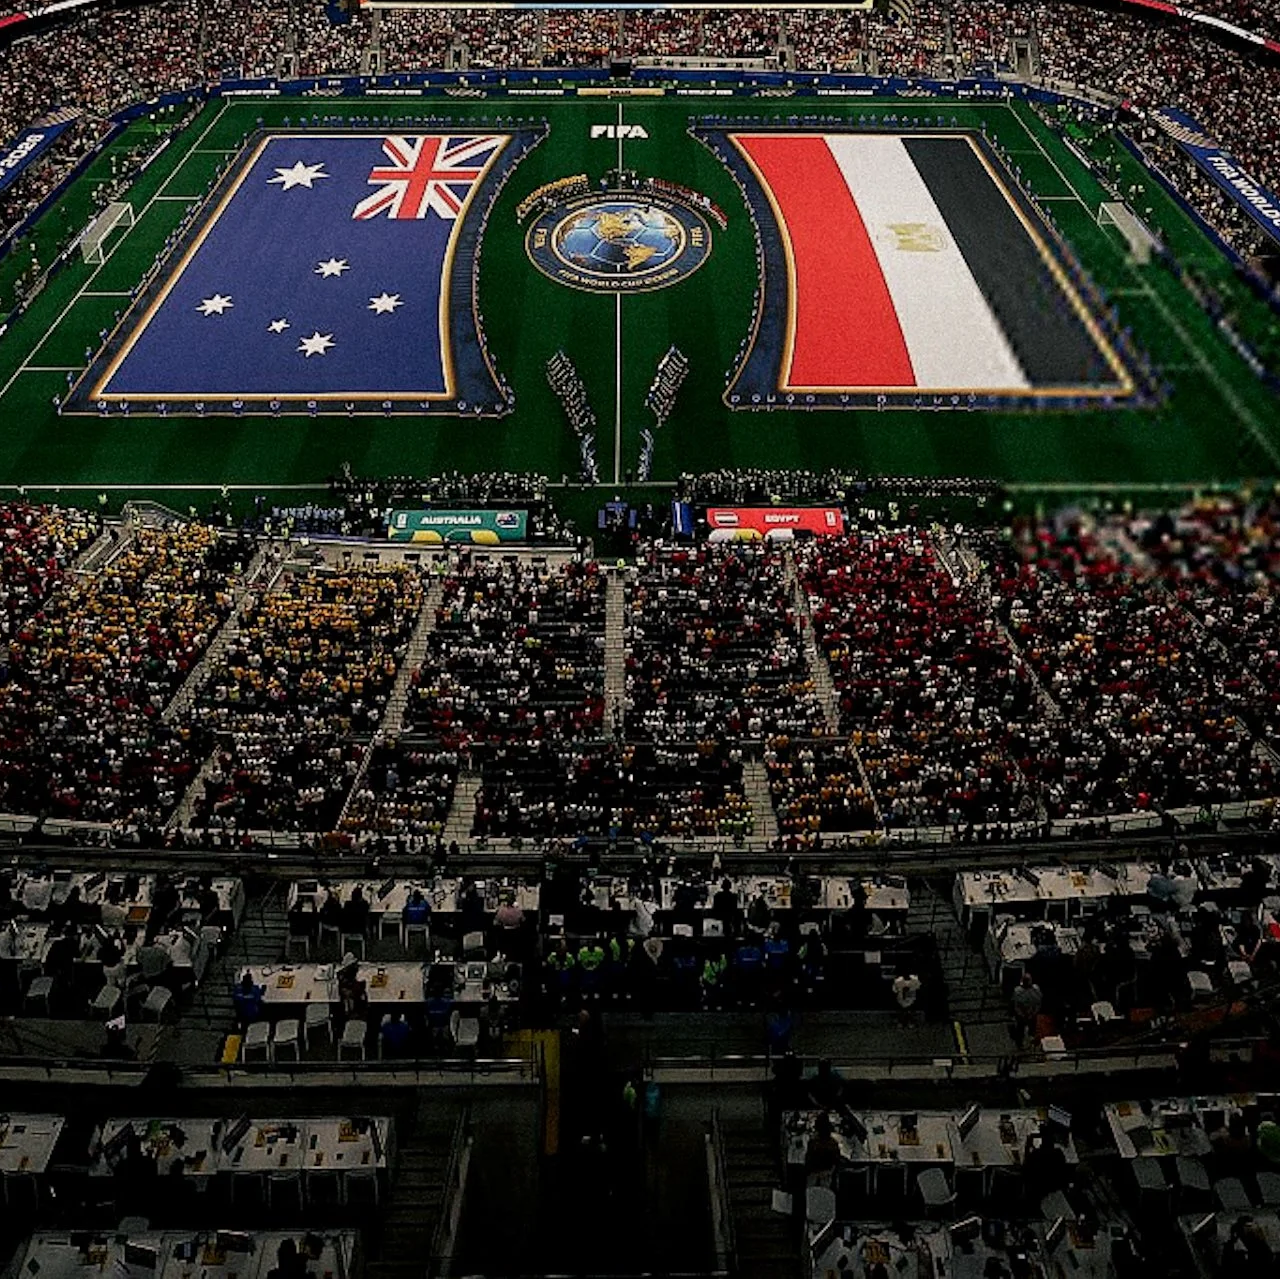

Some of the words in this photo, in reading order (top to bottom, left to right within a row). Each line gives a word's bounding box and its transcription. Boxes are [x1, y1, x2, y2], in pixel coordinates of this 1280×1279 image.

[590, 125, 649, 138] FIFA
[0, 133, 46, 168] 2026
[1207, 156, 1240, 179] FIFA
[581, 277, 619, 287] WORLD
[420, 515, 482, 525] AUSTRALIA
